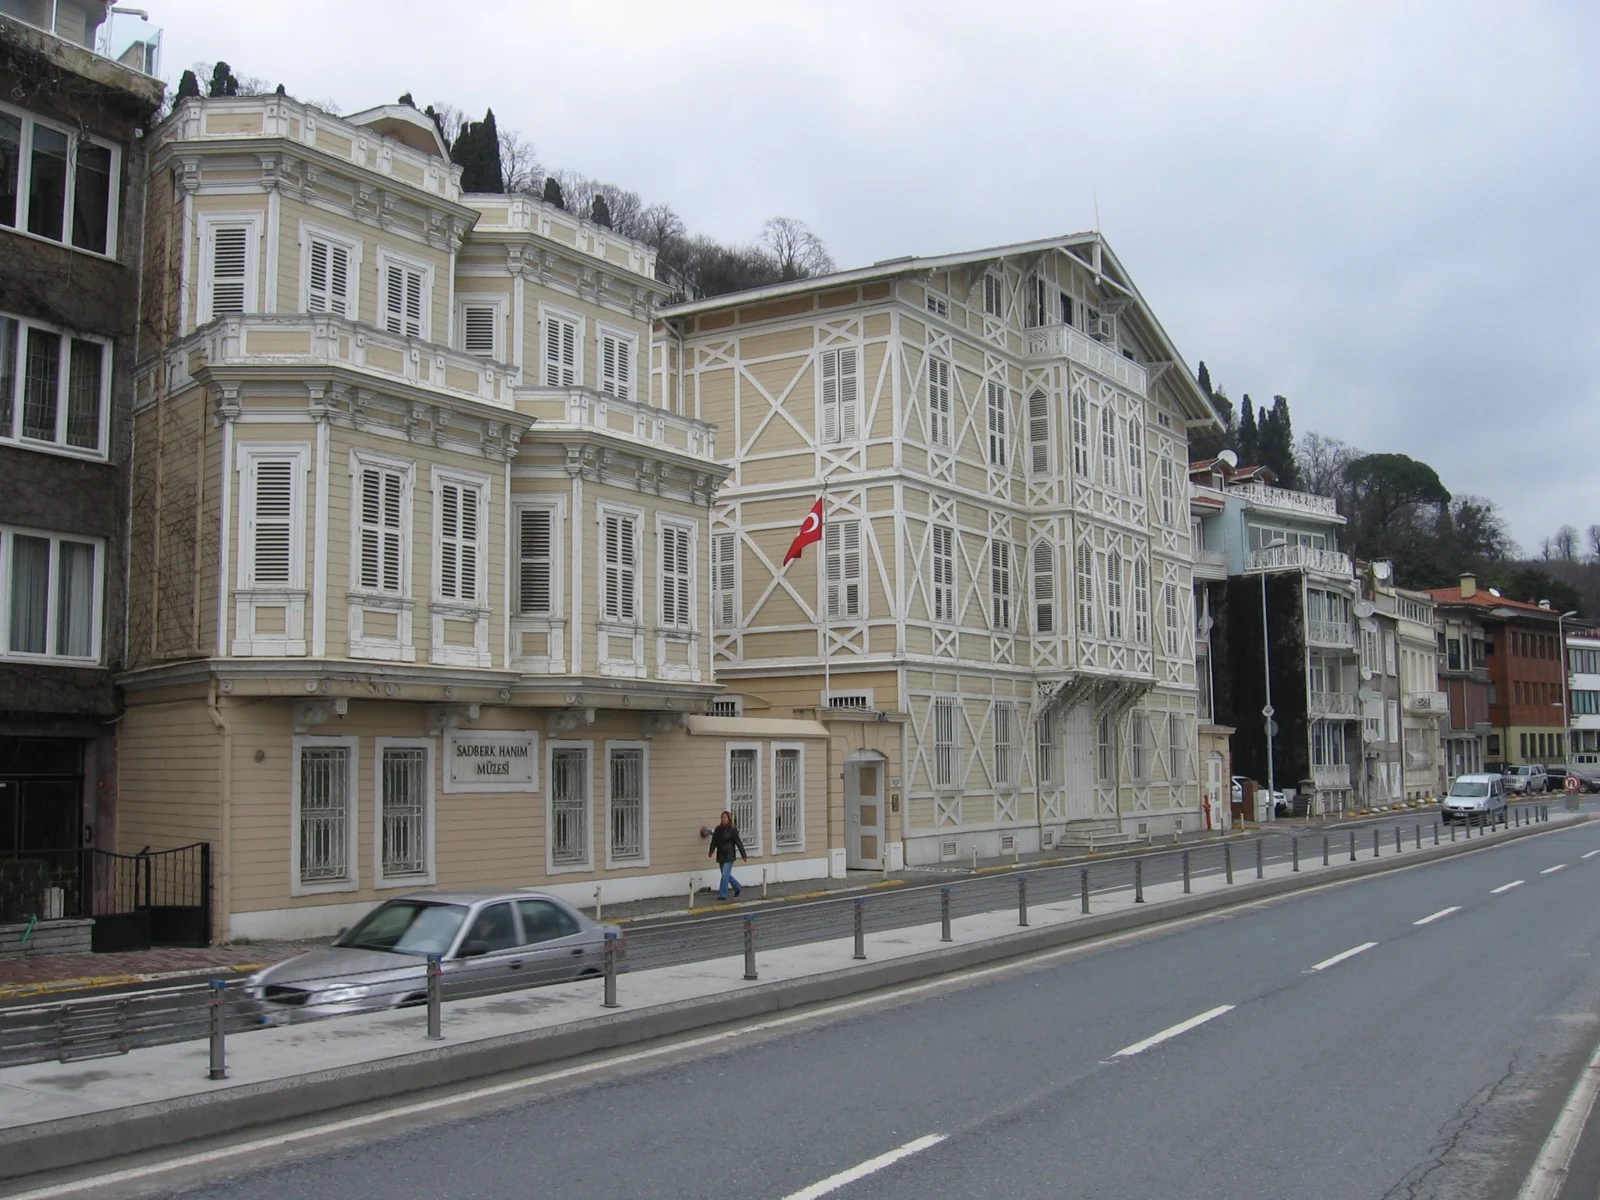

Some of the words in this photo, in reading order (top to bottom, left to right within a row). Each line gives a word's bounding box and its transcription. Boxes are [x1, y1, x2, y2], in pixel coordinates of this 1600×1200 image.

[456, 745, 495, 757] SADBERK
[499, 745, 528, 757] HANIM
[476, 761, 509, 775] MÜZESİ
